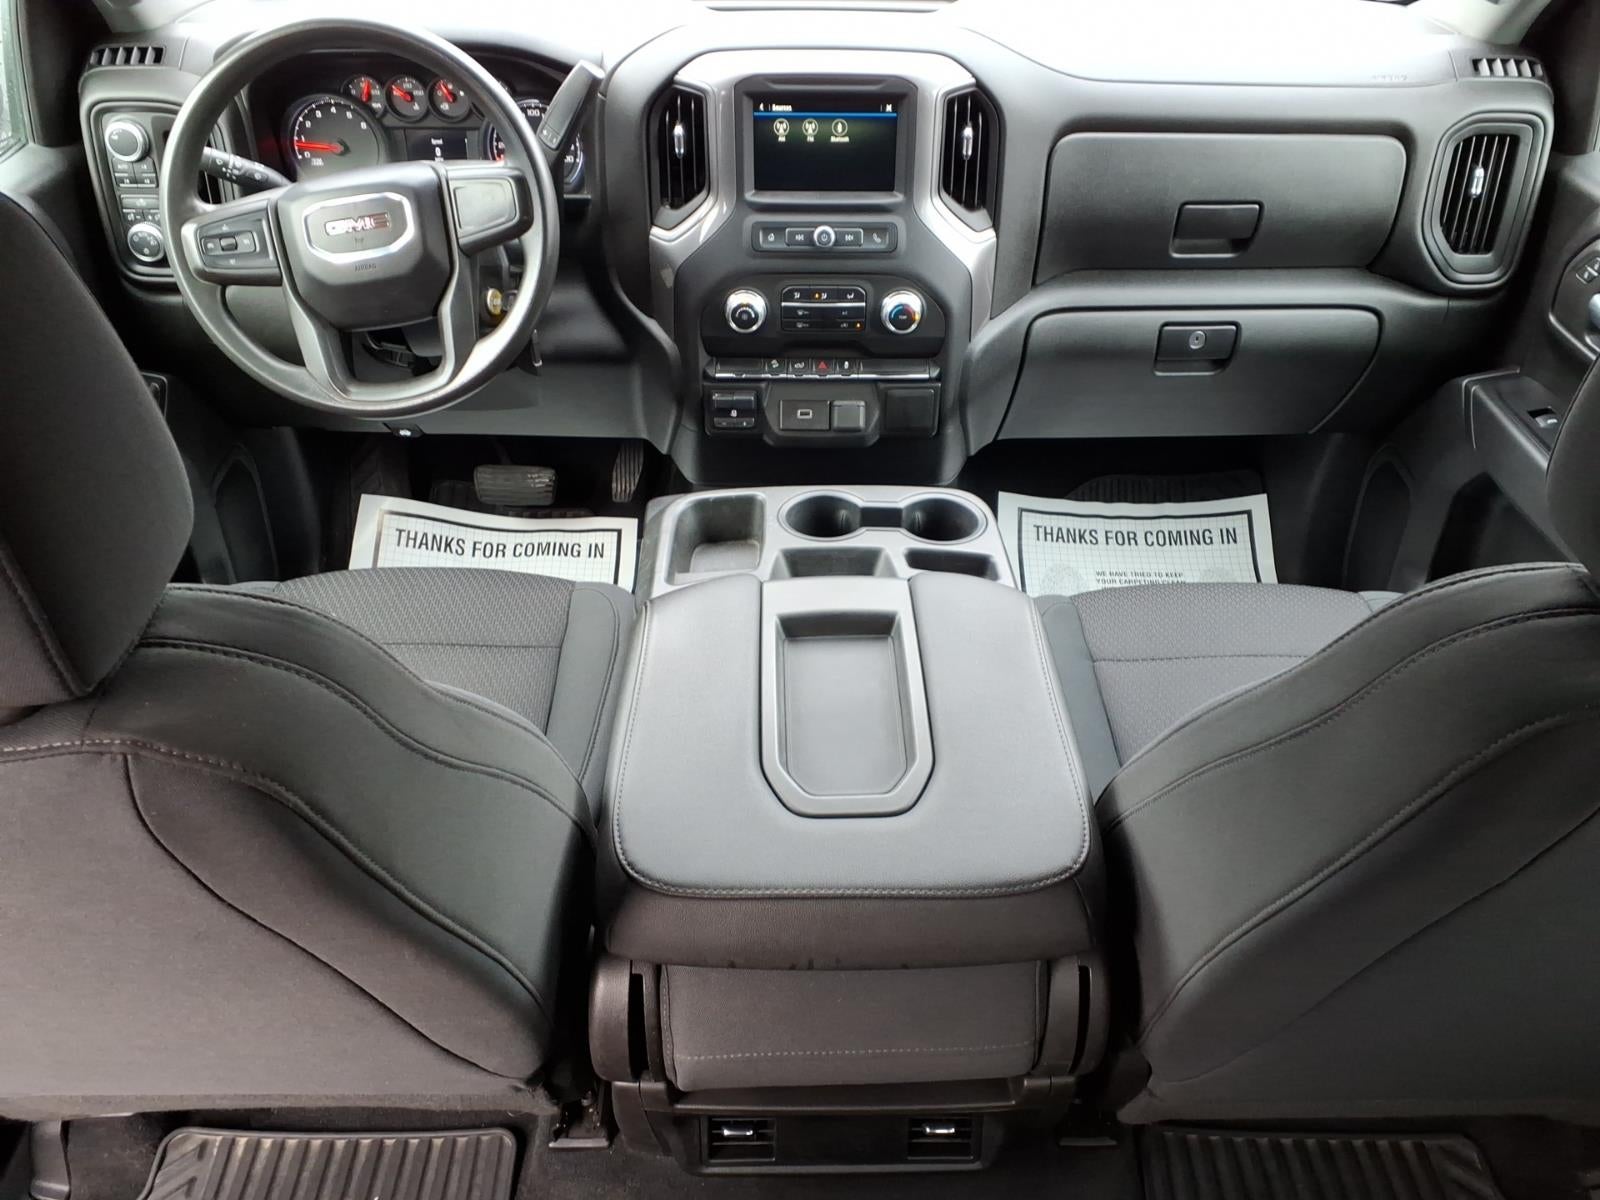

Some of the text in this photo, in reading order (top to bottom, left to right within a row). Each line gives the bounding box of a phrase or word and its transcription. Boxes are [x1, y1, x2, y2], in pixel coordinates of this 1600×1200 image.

[526, 108, 540, 117] 100
[395, 528, 605, 559] THANKS FOR COMING IN
[1033, 524, 1238, 547] THANKS FOR COMING IN
